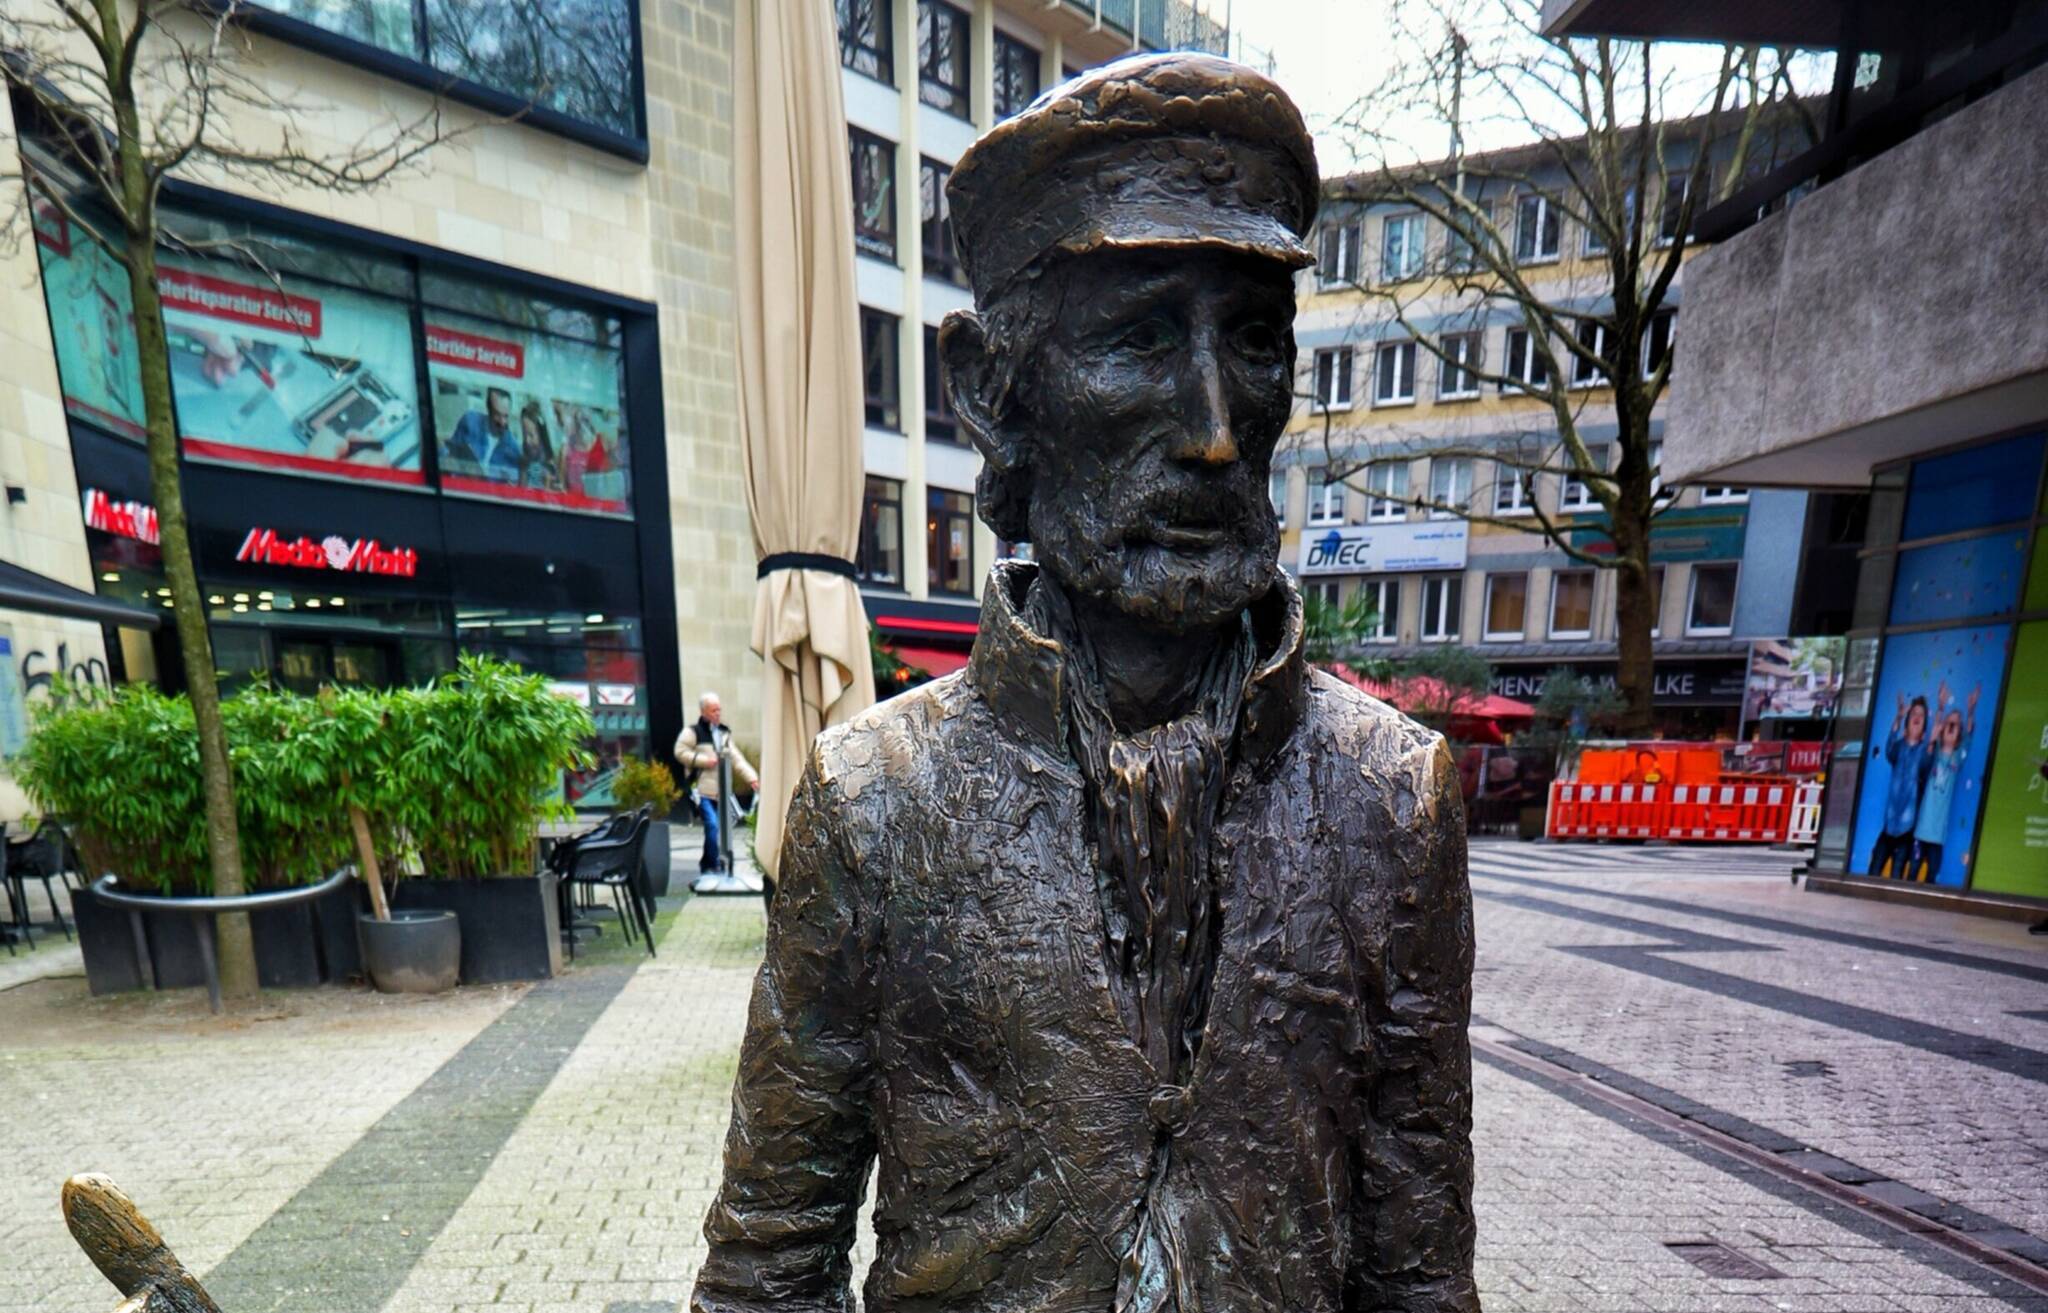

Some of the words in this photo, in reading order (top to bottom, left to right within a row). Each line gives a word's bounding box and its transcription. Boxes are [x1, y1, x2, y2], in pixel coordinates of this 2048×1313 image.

[158, 278, 262, 316] ofortreparatur
[262, 301, 313, 328] Service
[476, 347, 517, 371] Service
[236, 527, 328, 569] Media
[344, 538, 417, 578] Markt
[1486, 675, 1547, 696] MENZ
